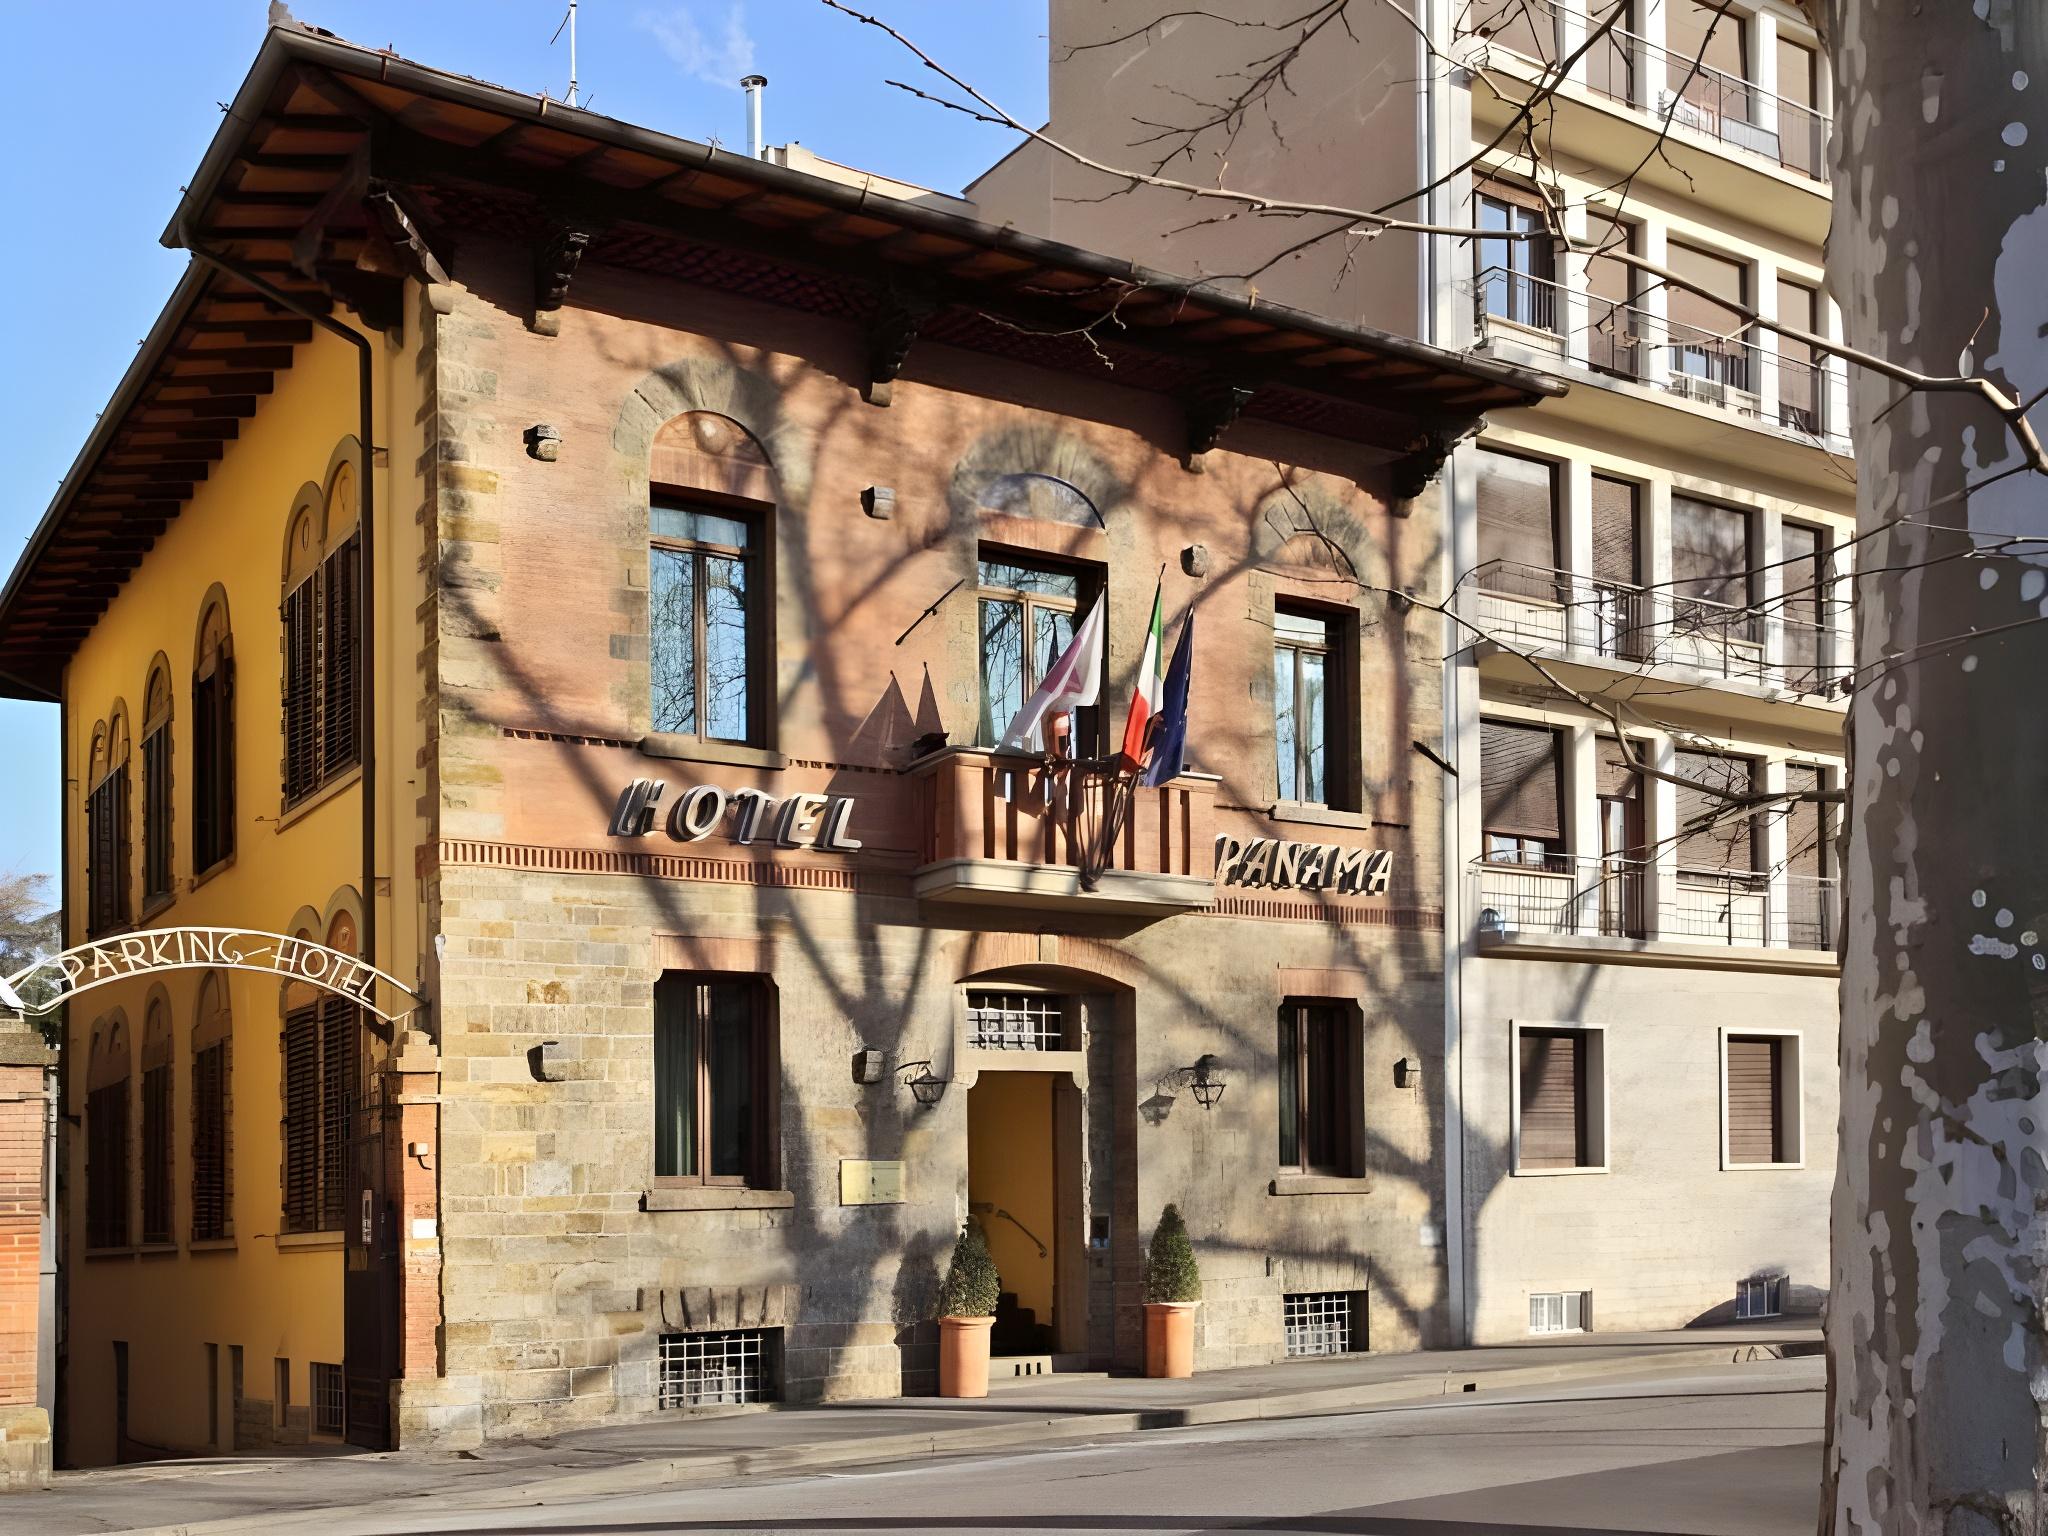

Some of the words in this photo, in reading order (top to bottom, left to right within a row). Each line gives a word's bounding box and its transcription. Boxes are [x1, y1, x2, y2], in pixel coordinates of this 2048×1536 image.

[608, 777, 863, 852] HOTEL
[1215, 833, 1393, 896] PANAMA
[57, 932, 244, 989] PARKING
[271, 938, 379, 1002] HOTEL
